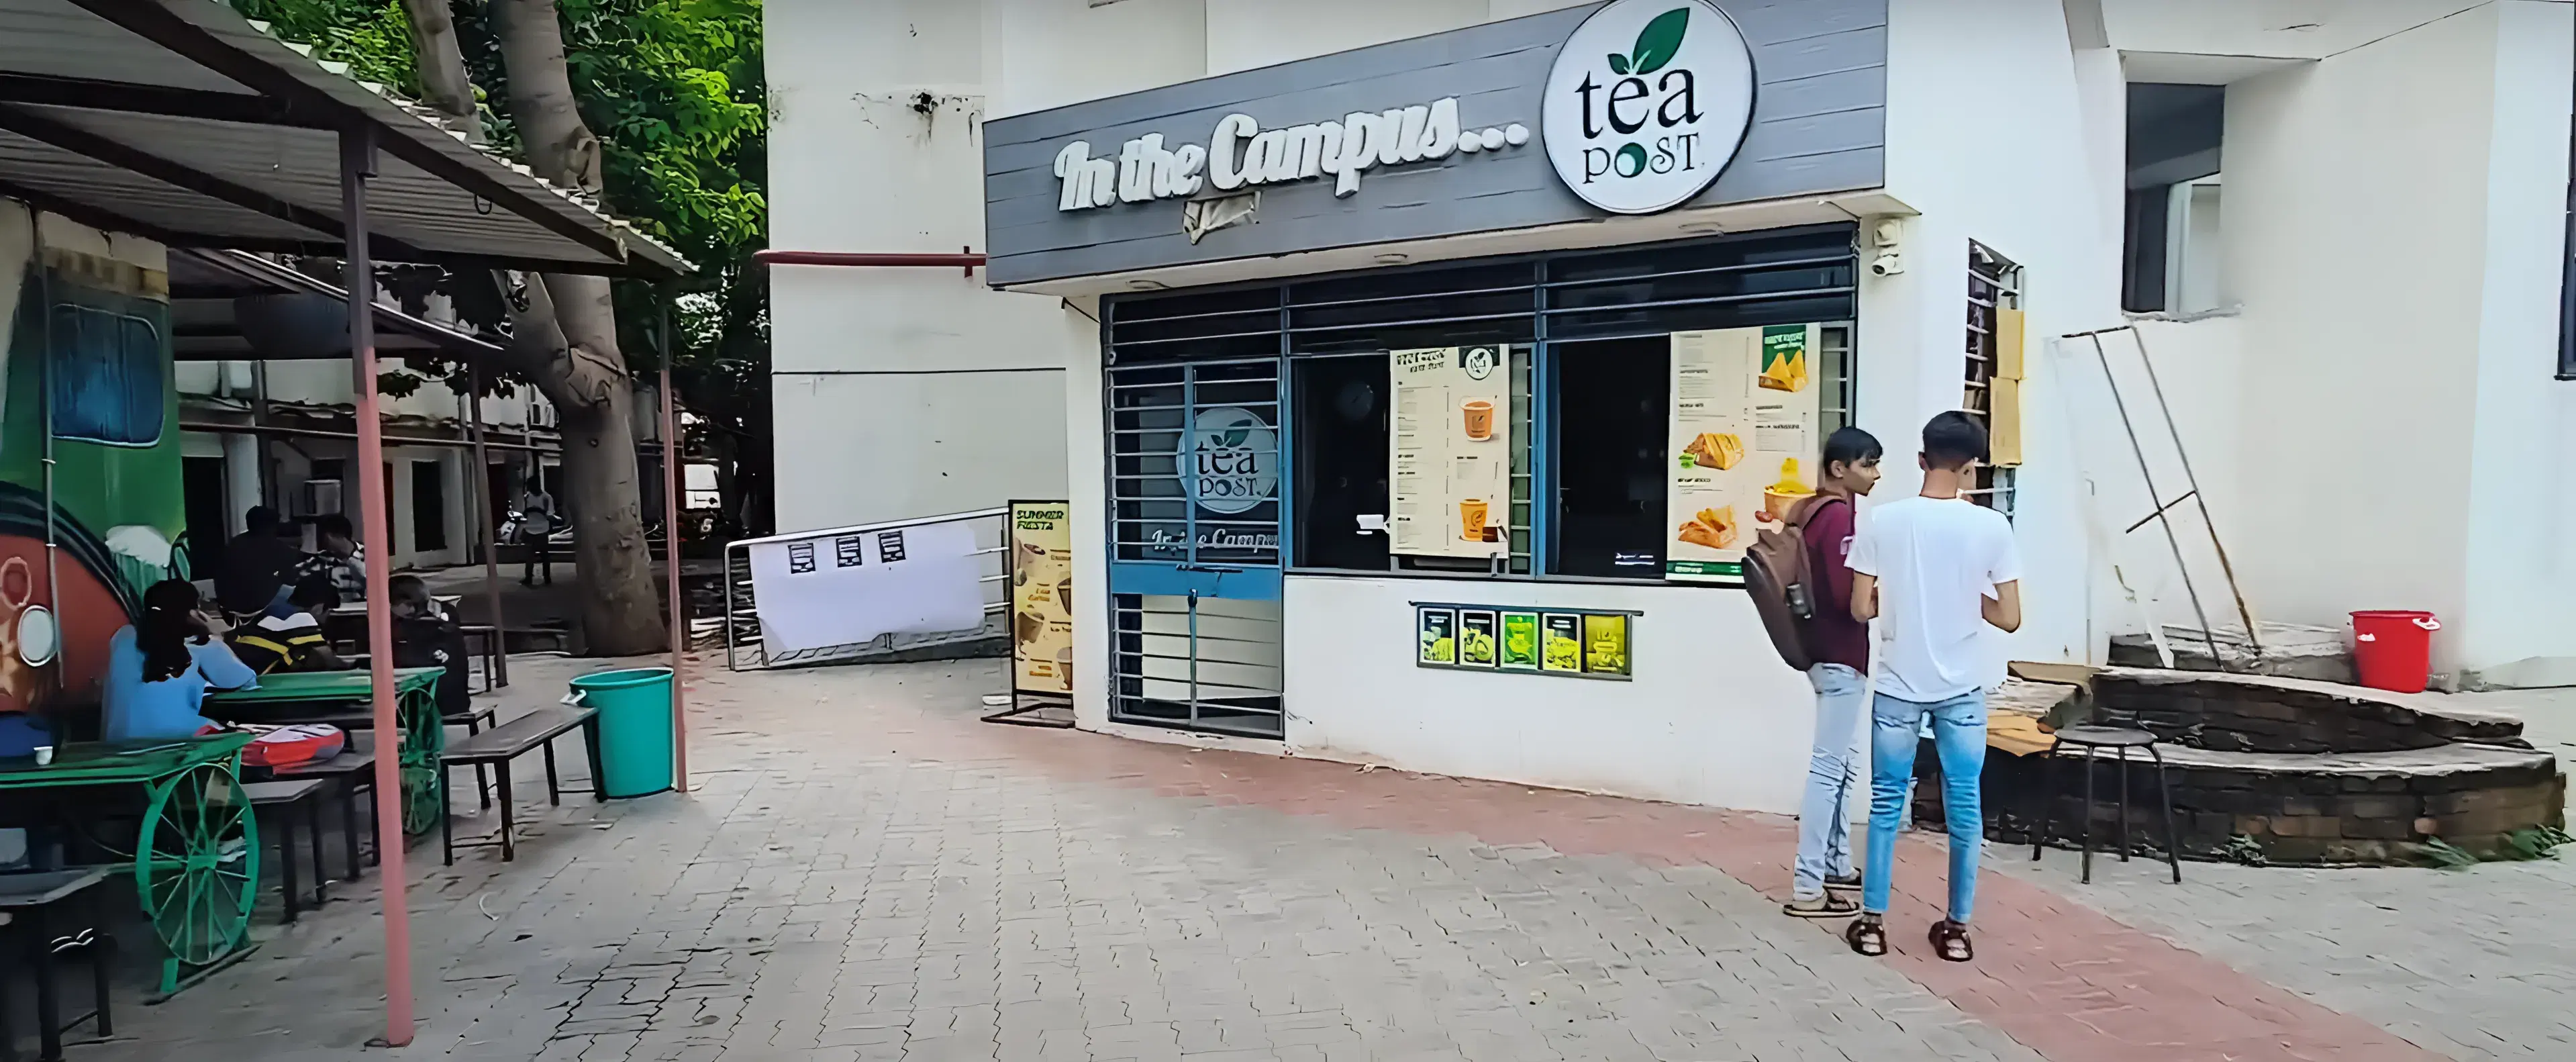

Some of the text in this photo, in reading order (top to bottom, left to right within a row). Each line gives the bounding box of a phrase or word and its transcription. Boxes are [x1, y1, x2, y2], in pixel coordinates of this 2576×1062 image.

[1574, 68, 1705, 139] tea
[1053, 140, 1116, 211] In
[1119, 132, 1206, 203] the
[1195, 440, 1259, 475] tea
